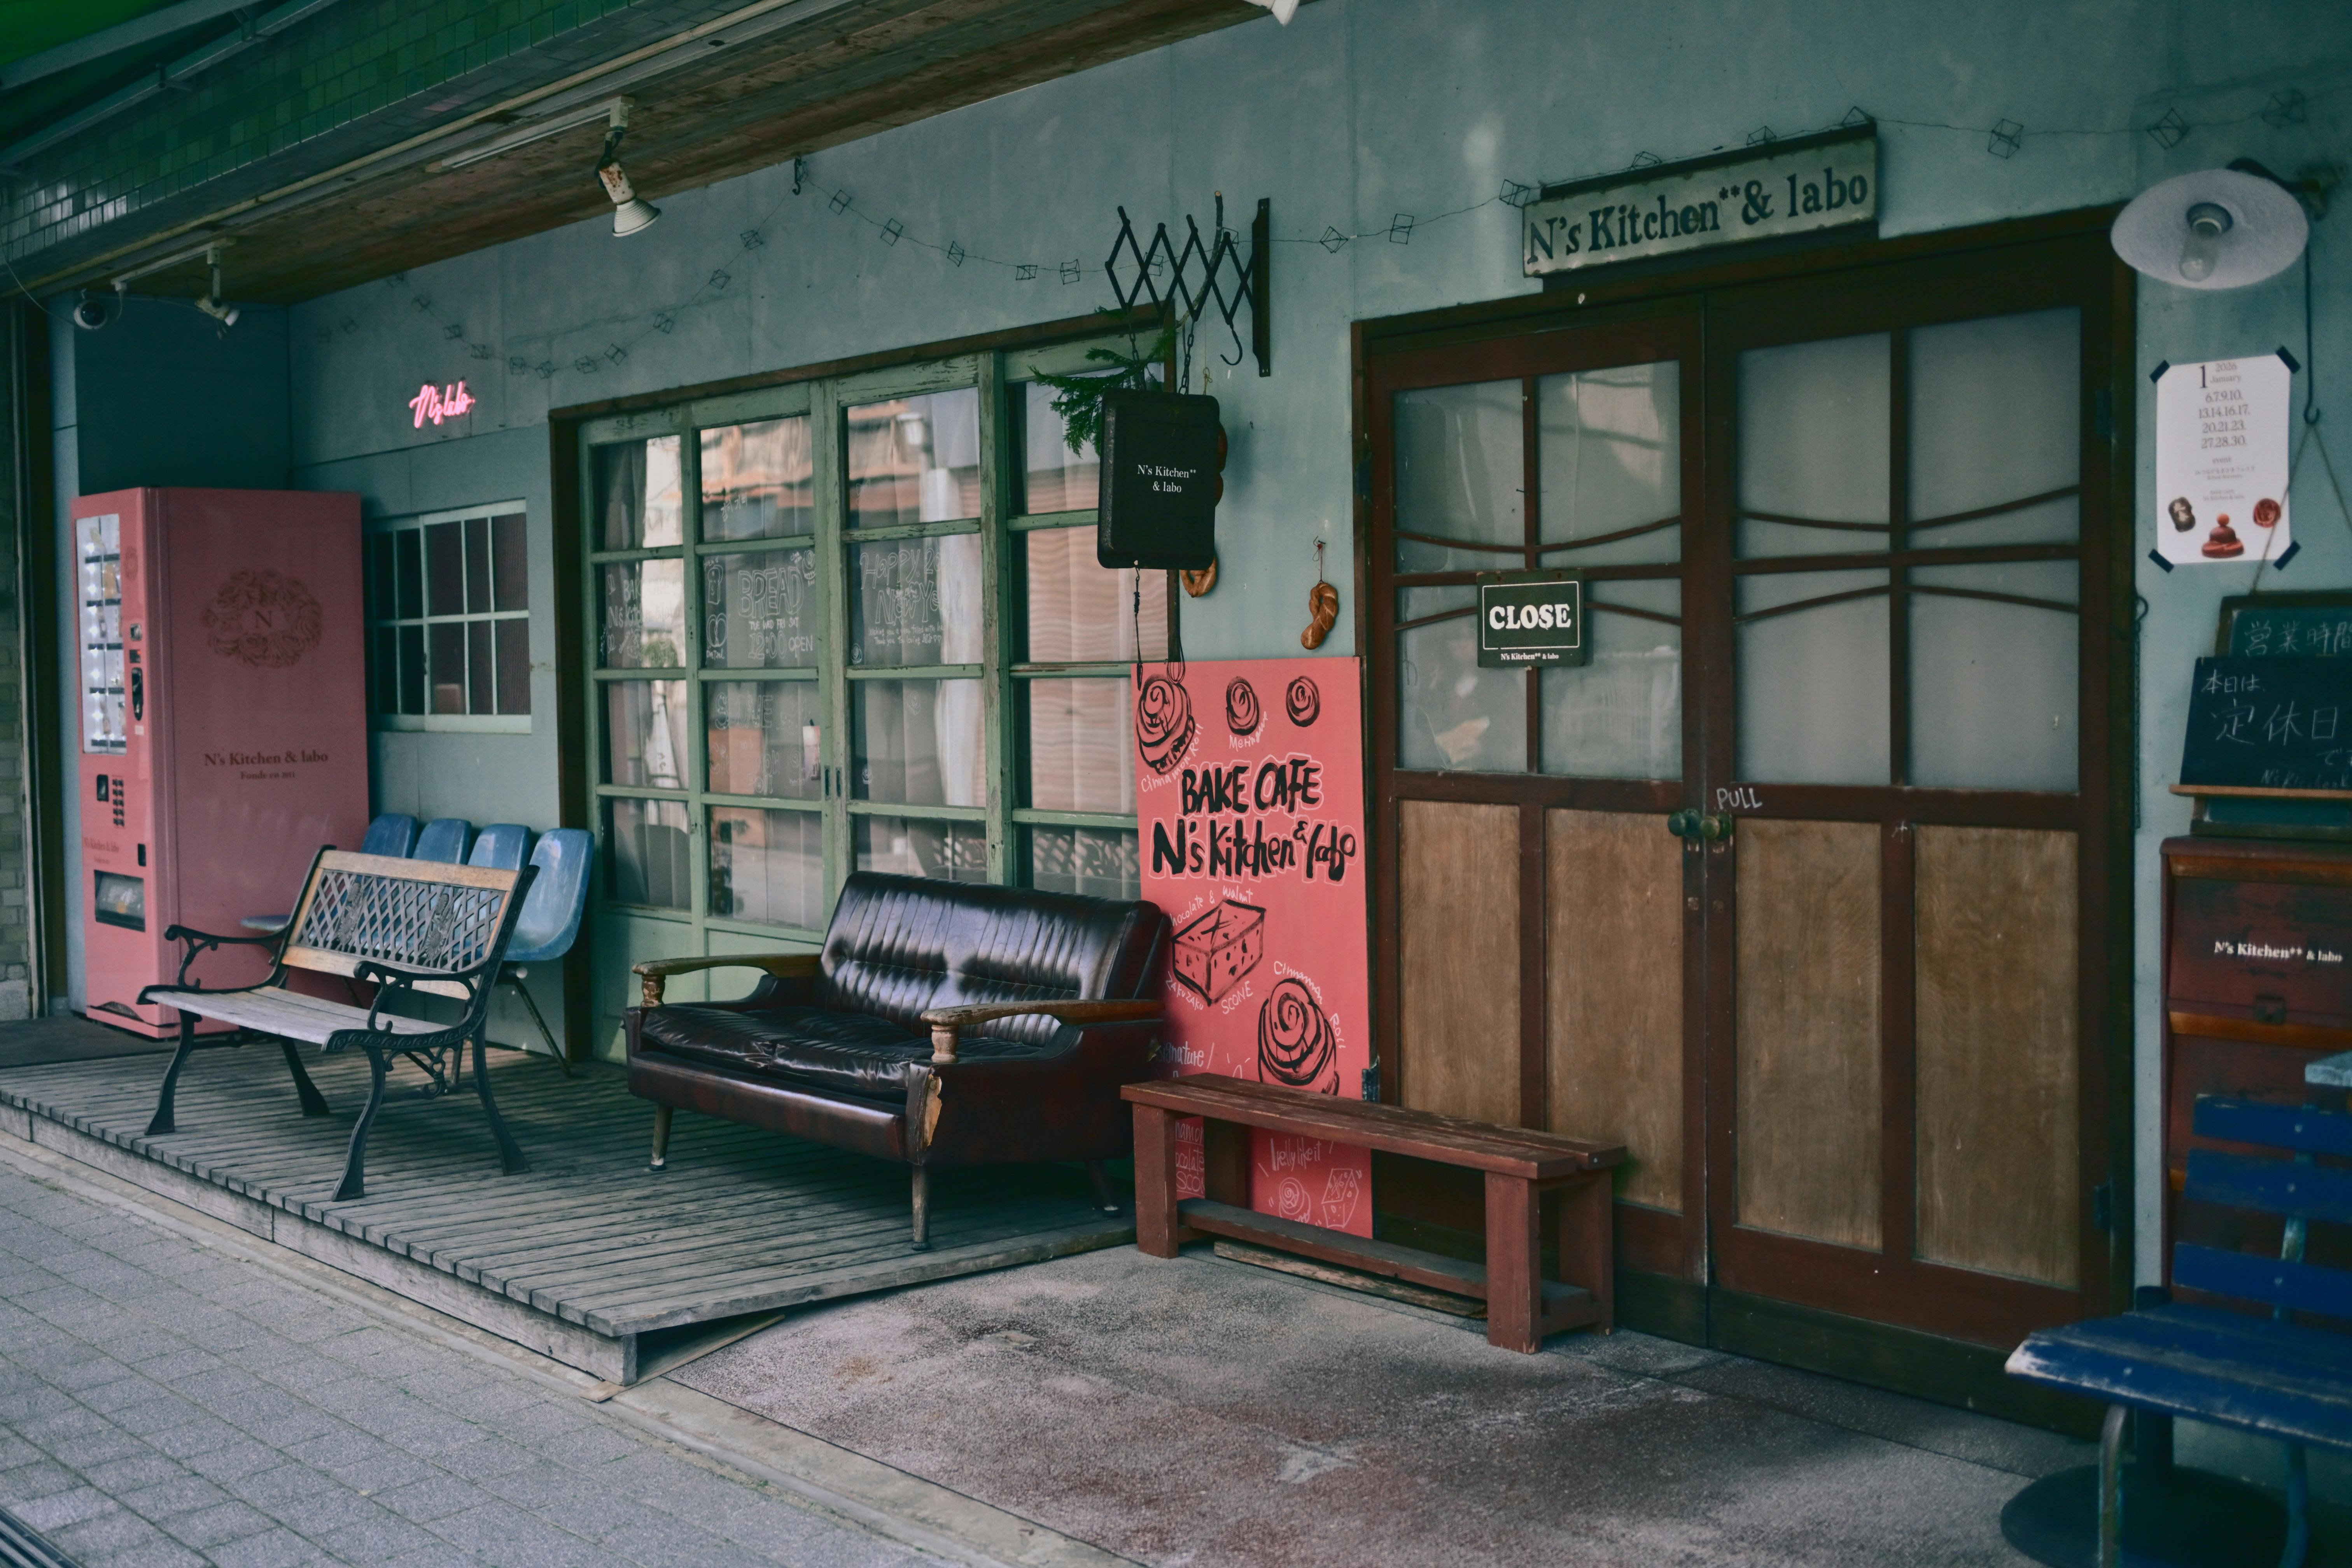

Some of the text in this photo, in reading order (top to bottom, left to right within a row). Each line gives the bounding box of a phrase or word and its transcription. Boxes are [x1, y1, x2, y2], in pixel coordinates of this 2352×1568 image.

[1527, 217, 1581, 265] N's
[1741, 180, 1774, 225] &
[1787, 167, 1868, 218] labo
[2199, 362, 2236, 389] 1 2026
[2210, 374, 2242, 383] January
[1137, 464, 1152, 475] N's
[1153, 481, 1182, 493] & labo
[737, 565, 805, 619] BREAD
[749, 616, 799, 630] TUE WED FRI SAT
[1489, 603, 1572, 630] CLOSE
[748, 630, 814, 660] 12:00 OPEN
[2210, 698, 2338, 746] 定休日
[204, 749, 329, 766] N's Kitchen & labo
[1141, 723, 1204, 792] Cinnamon Roll
[1182, 759, 1321, 816] BAKE CAFE
[1716, 787, 1763, 810] PULL
[1152, 818, 1356, 882] N's Kitchen & labo
[1169, 894, 1204, 927] hocolate
[1209, 889, 1215, 905] &
[2214, 941, 2235, 955] N's
[2306, 949, 2315, 961] &
[2318, 949, 2343, 963] labo
[1221, 980, 1253, 1015] SCONE
